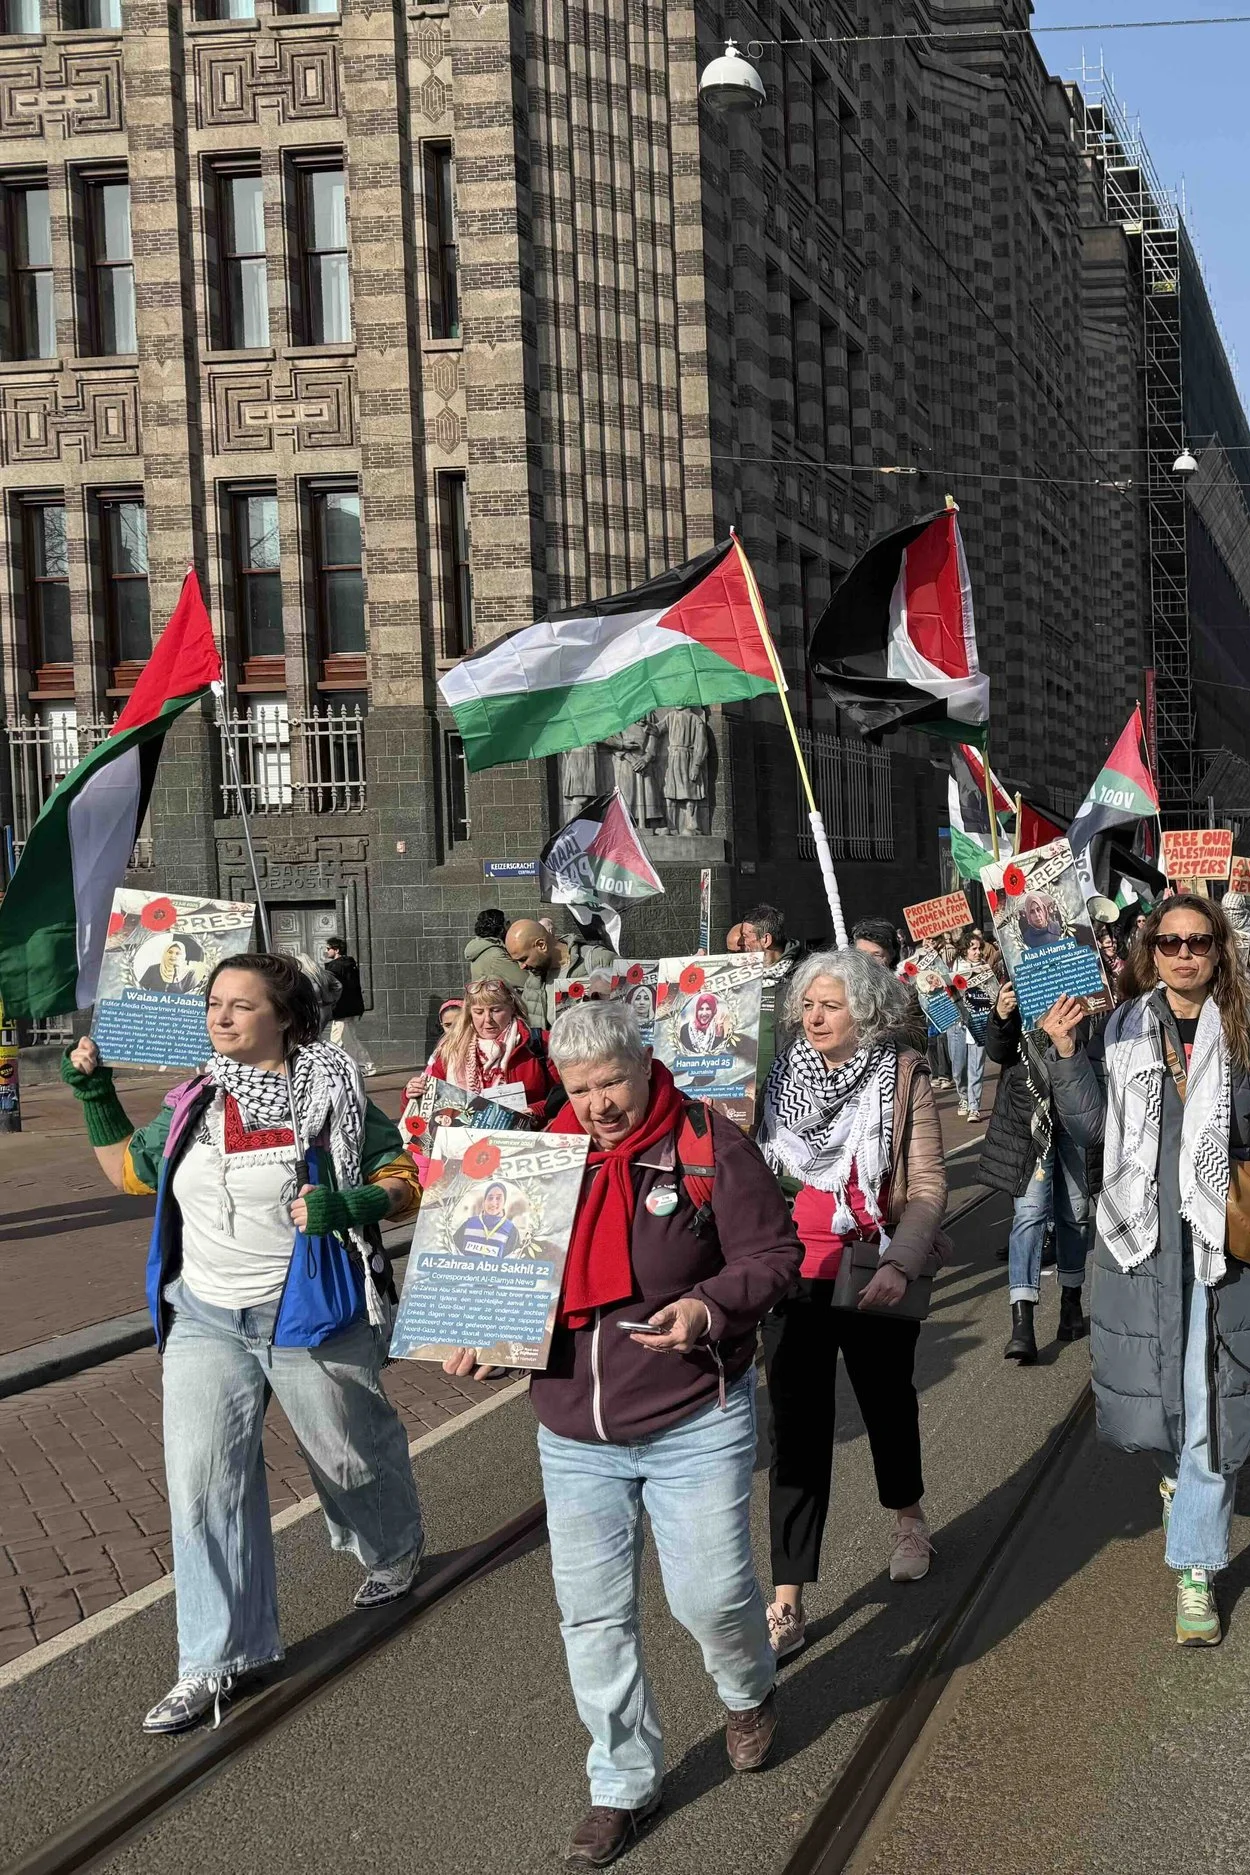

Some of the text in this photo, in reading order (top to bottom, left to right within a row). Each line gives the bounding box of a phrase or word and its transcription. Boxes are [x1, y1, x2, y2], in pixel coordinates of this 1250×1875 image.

[1164, 831, 1231, 848] FREE OUR
[1164, 846, 1230, 859] PALESTINIAN
[491, 862, 535, 870] KEIZERSGRACHT
[1025, 849, 1073, 889] PRESS
[1167, 860, 1227, 876] SISTERS
[1236, 858, 1245, 867] A
[271, 866, 319, 876] SAFE
[260, 877, 331, 889] DEPOSIT
[905, 893, 964, 919] PROTECT ALL
[908, 902, 968, 928] WOMEN FROM
[913, 913, 970, 939] IMPERIALISM
[1024, 951, 1039, 961] Alaa
[1067, 941, 1075, 949] 35
[708, 963, 763, 991] PRESS
[126, 991, 206, 1007] Walaa Al-Jaaba
[676, 1060, 699, 1068] Hanan
[701, 1059, 720, 1069] Ayad
[421, 1257, 549, 1275] Al-Zahraa Abu Sakhil 22
[432, 1272, 480, 1282] Correspondent
[515, 1278, 534, 1286] News
